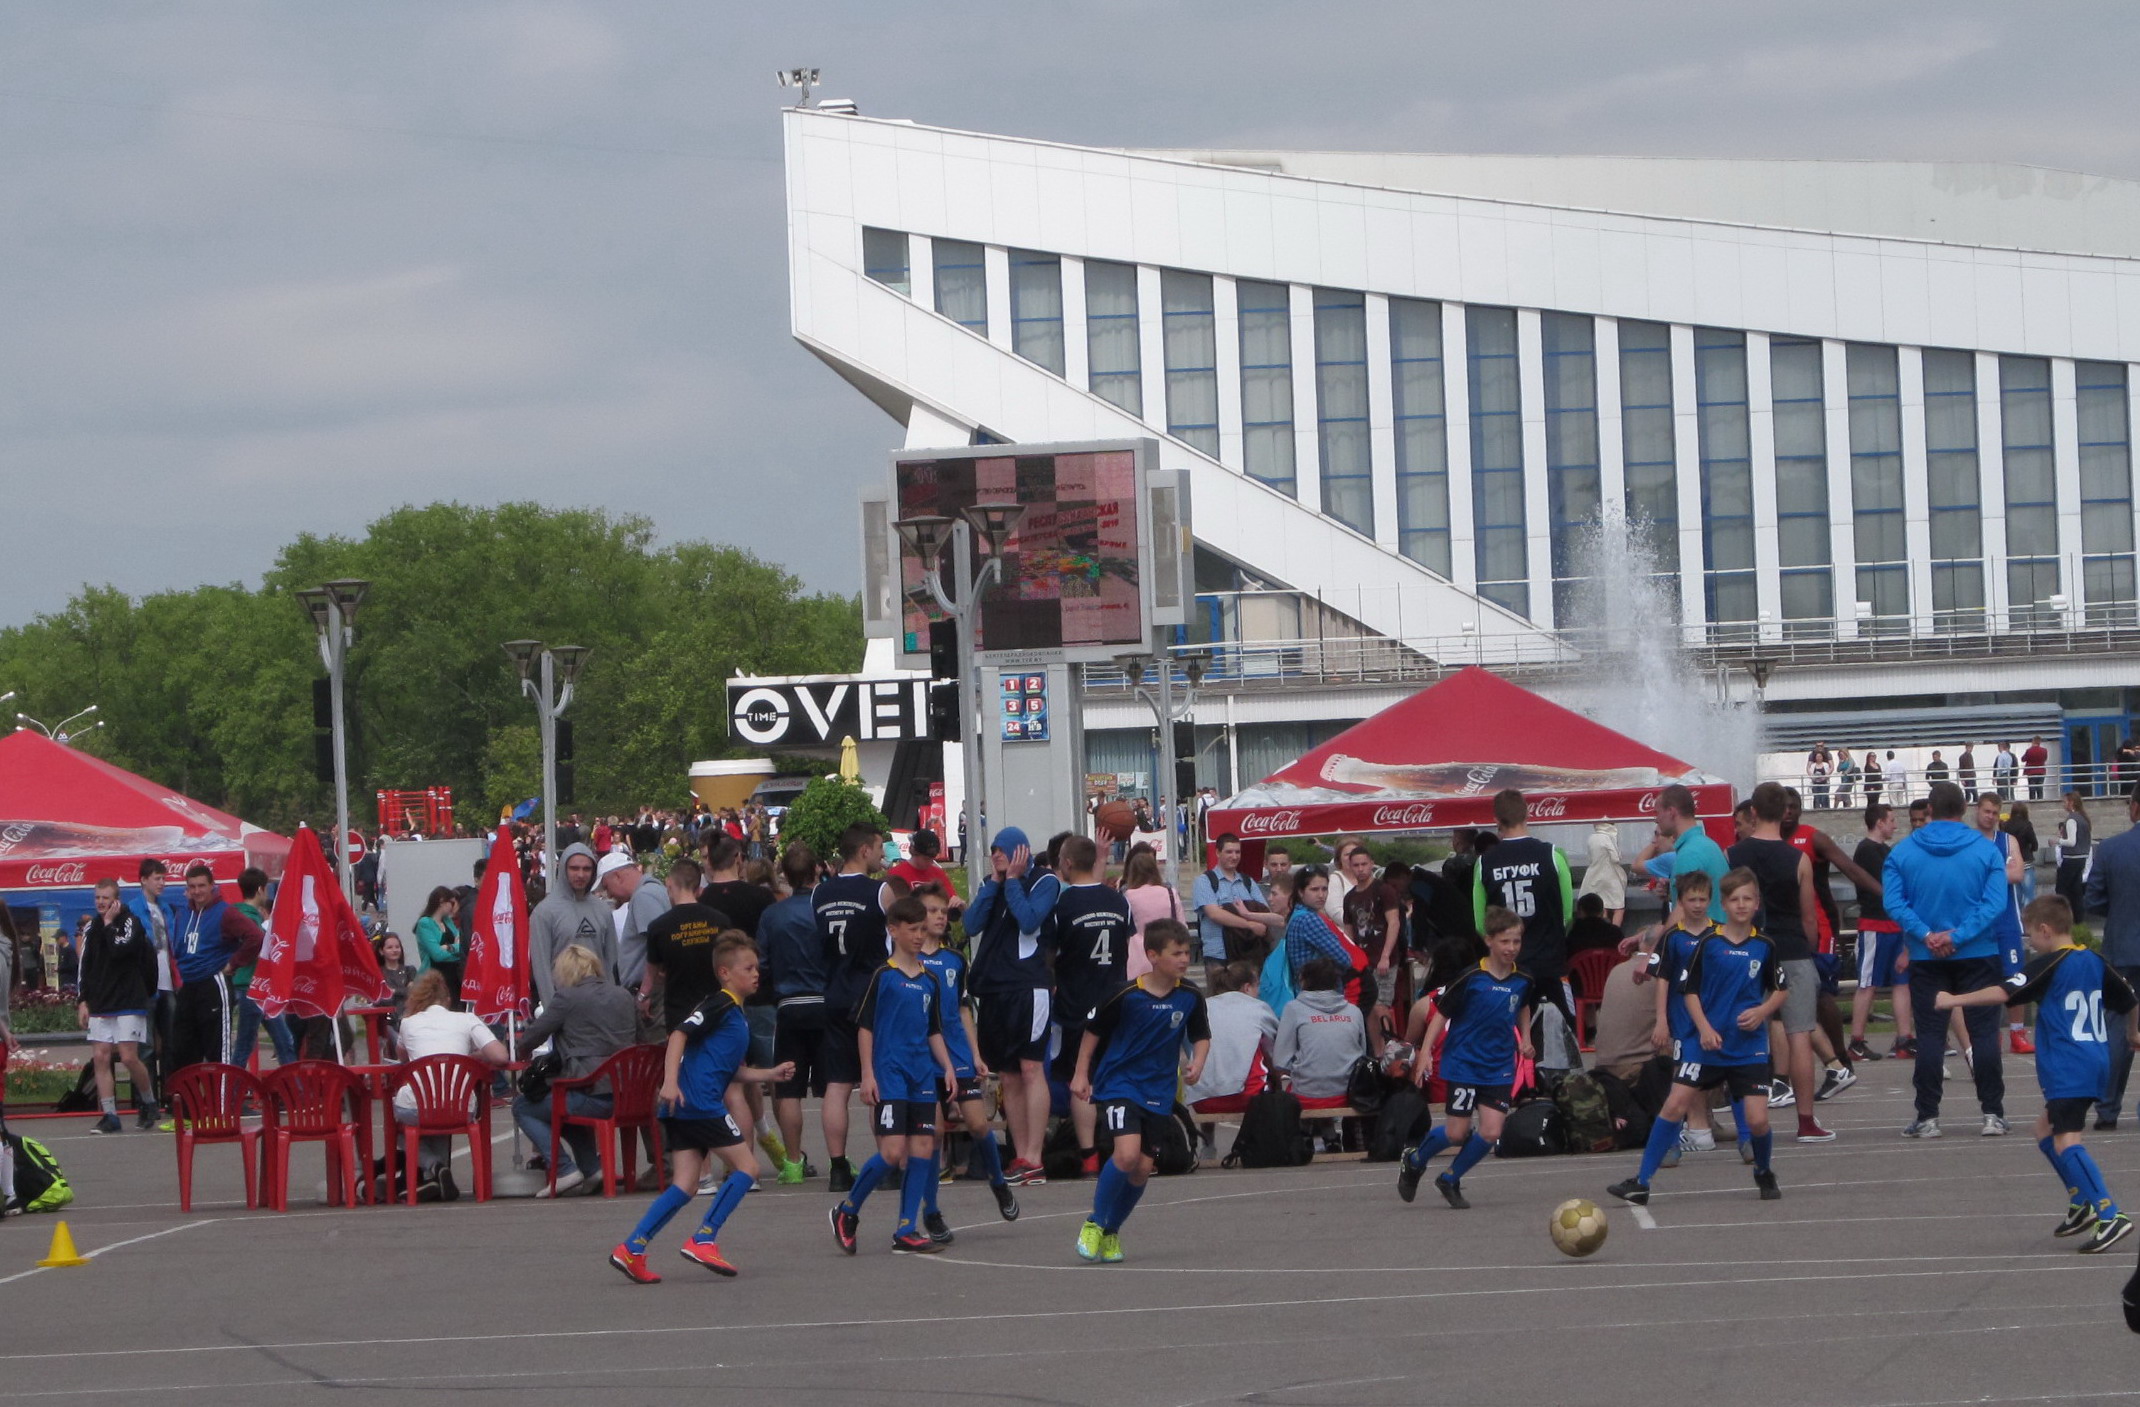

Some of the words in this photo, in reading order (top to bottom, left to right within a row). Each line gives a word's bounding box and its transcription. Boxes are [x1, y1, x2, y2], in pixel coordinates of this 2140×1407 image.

[1008, 680, 1015, 690] 1
[1029, 679, 1038, 689] 2
[1008, 701, 1017, 711] 3
[1030, 700, 1039, 710] 5
[747, 711, 778, 723] TIME
[1007, 722, 1020, 732] 24
[1240, 810, 1303, 834] Coca-Cola
[1373, 803, 1436, 826] Coca-Cola
[26, 862, 88, 884] Coca-Cola
[1492, 863, 1540, 881] БГУФК
[1501, 879, 1536, 917] 15
[828, 920, 847, 954] 7
[1090, 929, 1113, 965] 4
[2010, 948, 2018, 964] 6
[1310, 1015, 1352, 1024] BELARUS
[2064, 989, 2108, 1043] 20
[1679, 1062, 1702, 1082] 14
[724, 1113, 741, 1137] 9
[880, 1104, 895, 1129] 4
[1106, 1105, 1126, 1130] 11
